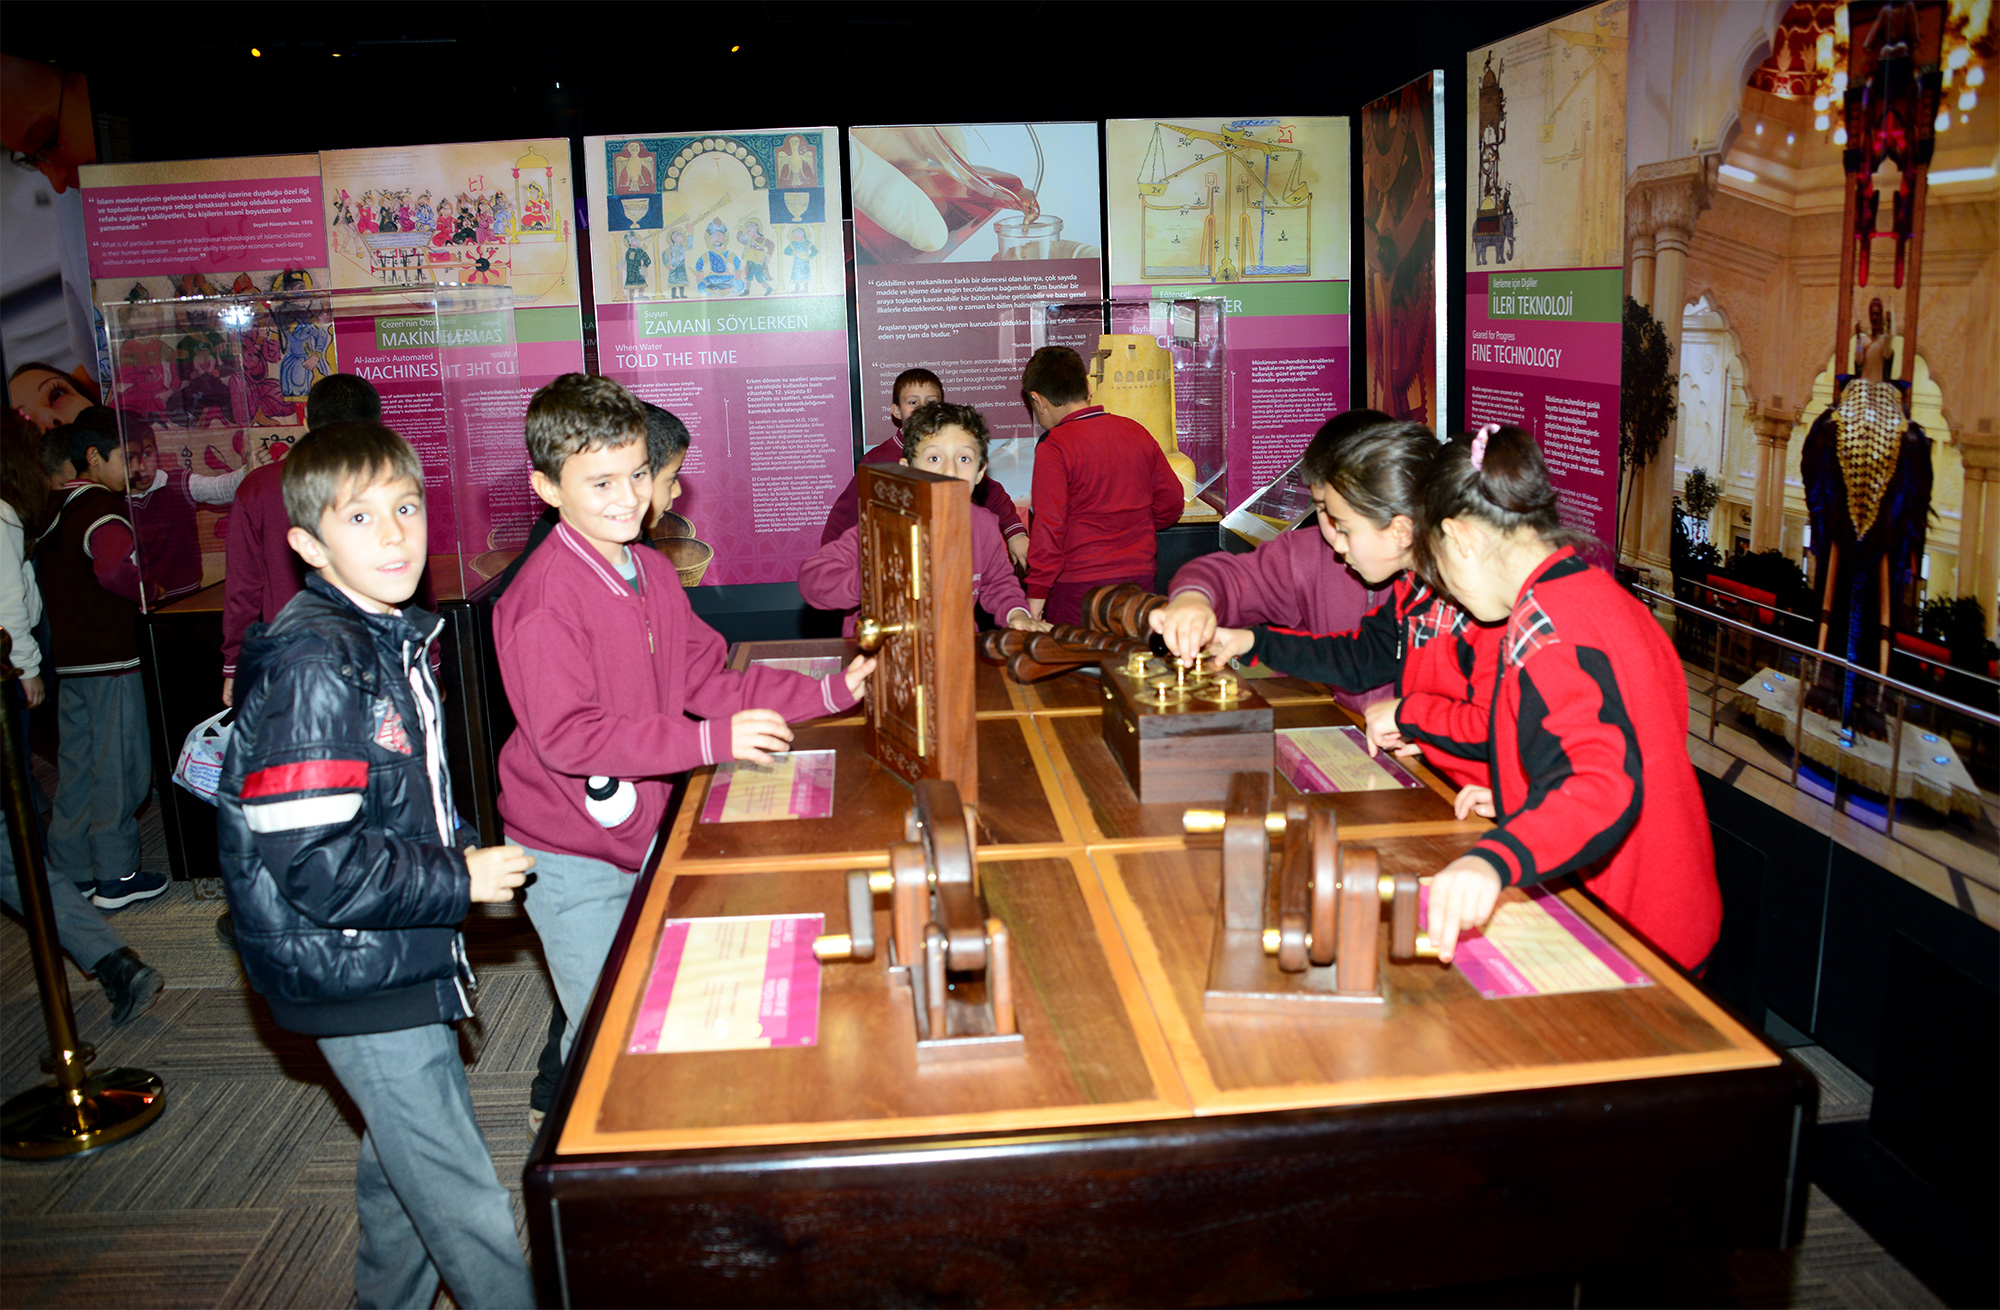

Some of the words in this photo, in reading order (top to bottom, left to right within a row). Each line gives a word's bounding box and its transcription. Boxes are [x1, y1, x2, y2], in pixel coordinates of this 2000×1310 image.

[116, 196, 162, 204] medeniyetinin
[163, 194, 197, 202] geleneksel
[198, 192, 226, 202] teknoloji
[228, 191, 252, 200] üzerine
[253, 190, 282, 200] duyduğu
[284, 189, 297, 197] özel
[299, 188, 309, 198] ilgi
[1023, 276, 1044, 285] kimya,
[1045, 275, 1056, 284] çok
[1058, 274, 1078, 284] sayıda
[1493, 277, 1511, 288] İlerleme
[1512, 278, 1520, 290] için
[1522, 278, 1537, 290] Dişliler
[1012, 293, 1046, 302] getirilebilir
[1493, 291, 1515, 314] İLERİ
[1518, 291, 1573, 316] TEKNOLOJİ
[645, 310, 668, 318] Suyun
[646, 319, 711, 335] ZAMANI
[717, 313, 808, 332] SÖYLERKEN
[940, 322, 968, 331] kimyanın
[1472, 330, 1488, 340] Geared
[1496, 331, 1515, 342] Progress
[354, 354, 390, 363] Al-Jazari's
[392, 353, 433, 362] Automated
[616, 354, 658, 368] TOLD
[663, 352, 693, 366] THE
[698, 350, 737, 364] TIME
[1472, 344, 1491, 362] FINE
[1494, 345, 1561, 368] TECHNOLOGY
[355, 363, 438, 380] MACHINES
